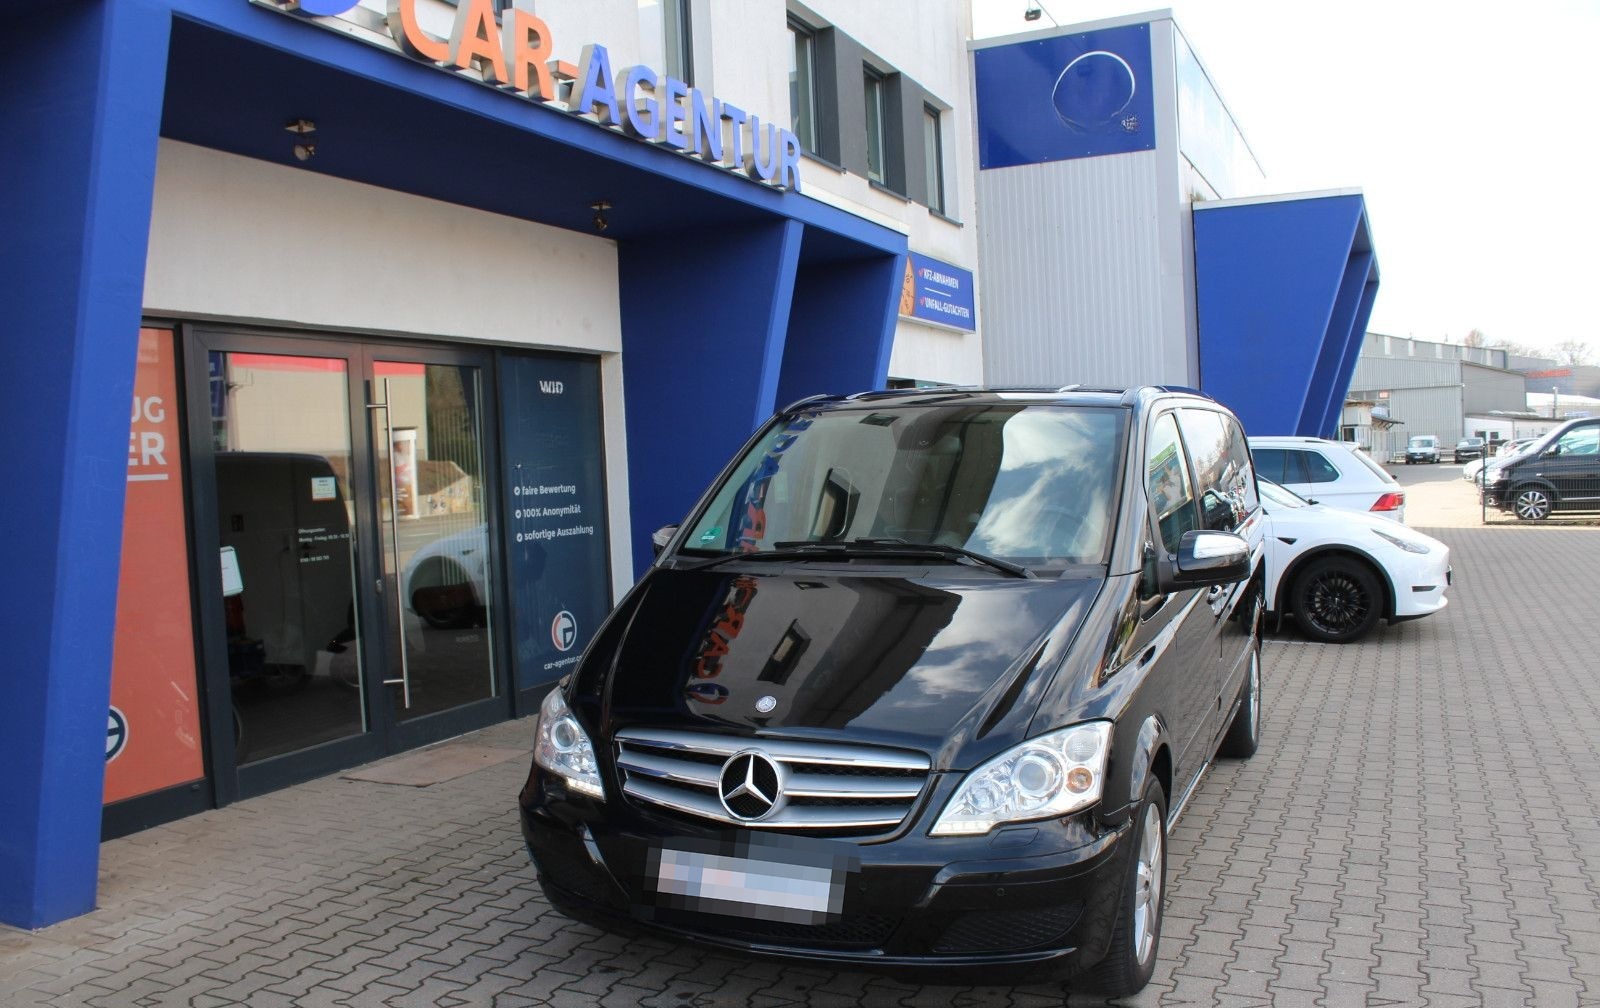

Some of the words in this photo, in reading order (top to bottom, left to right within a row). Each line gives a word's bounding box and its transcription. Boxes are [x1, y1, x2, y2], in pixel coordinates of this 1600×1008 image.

[397, 0, 801, 192] CAR-AGENTUR
[521, 485, 539, 496] faire
[539, 484, 576, 495] Bewertung
[523, 507, 542, 518] 100%
[542, 504, 582, 517] Anonymität
[524, 528, 556, 541] sofortige
[556, 524, 594, 538] Auszahlung
[543, 655, 583, 670] car-agentur.co
